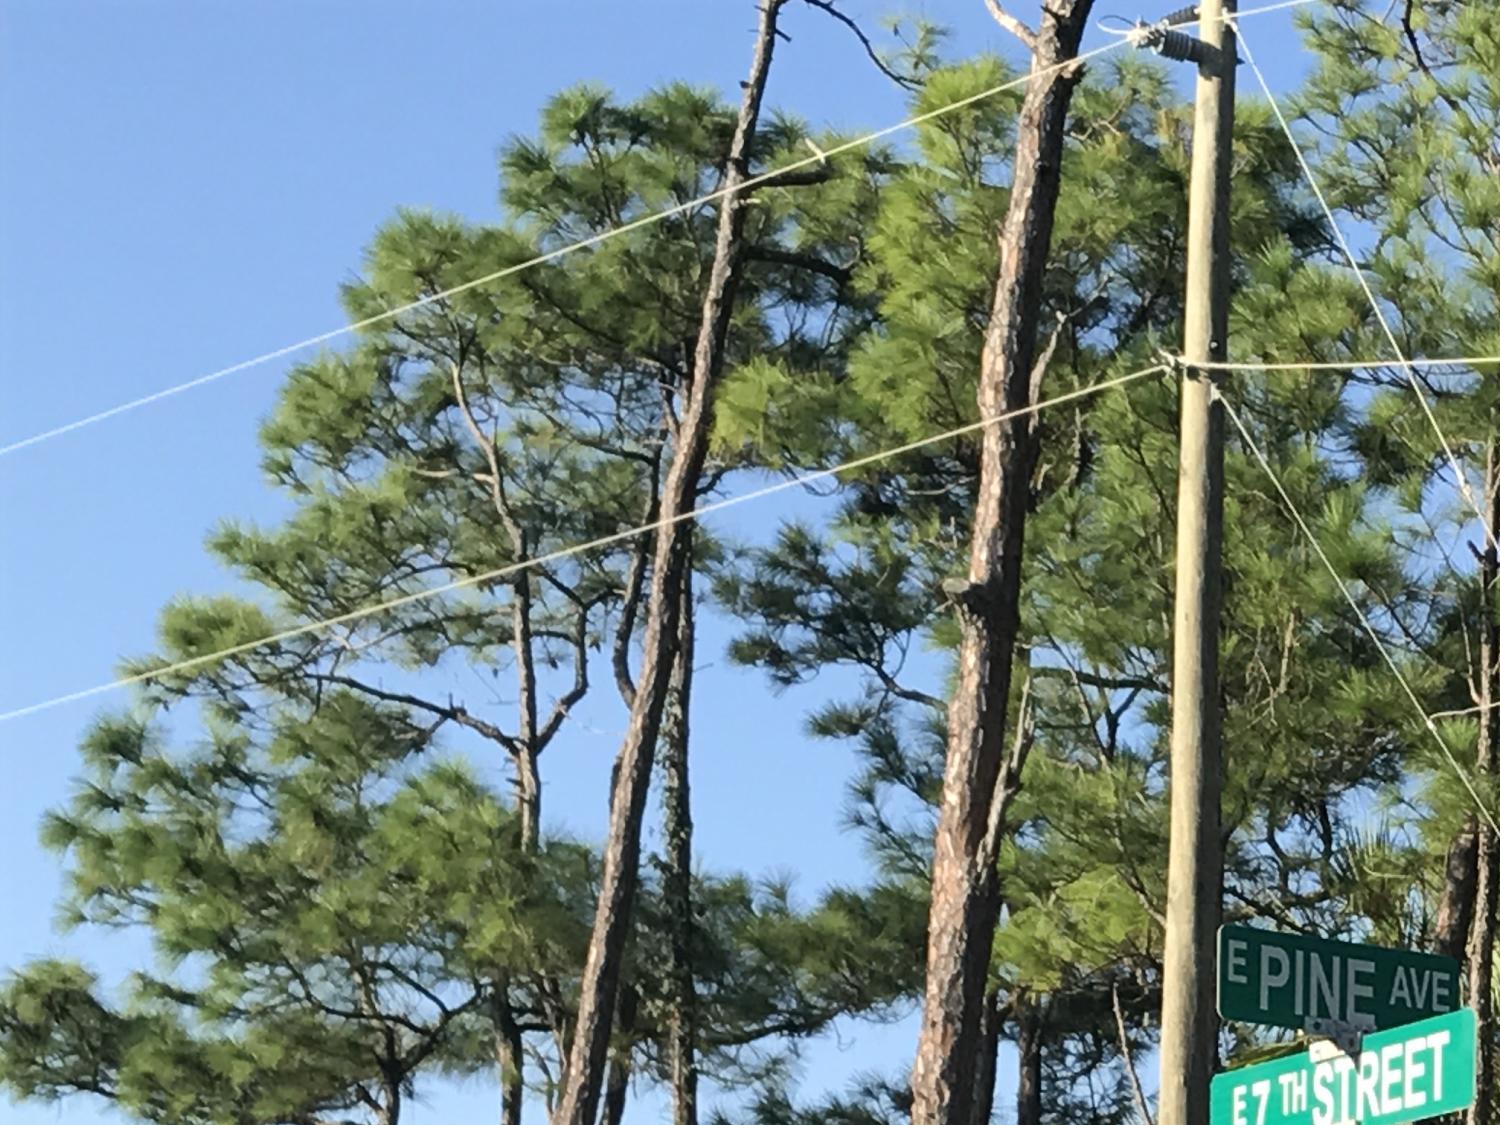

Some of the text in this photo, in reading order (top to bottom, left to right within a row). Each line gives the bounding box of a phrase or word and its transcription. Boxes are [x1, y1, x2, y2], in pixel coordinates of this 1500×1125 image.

[1227, 939, 1451, 1024] E PINE AVE
